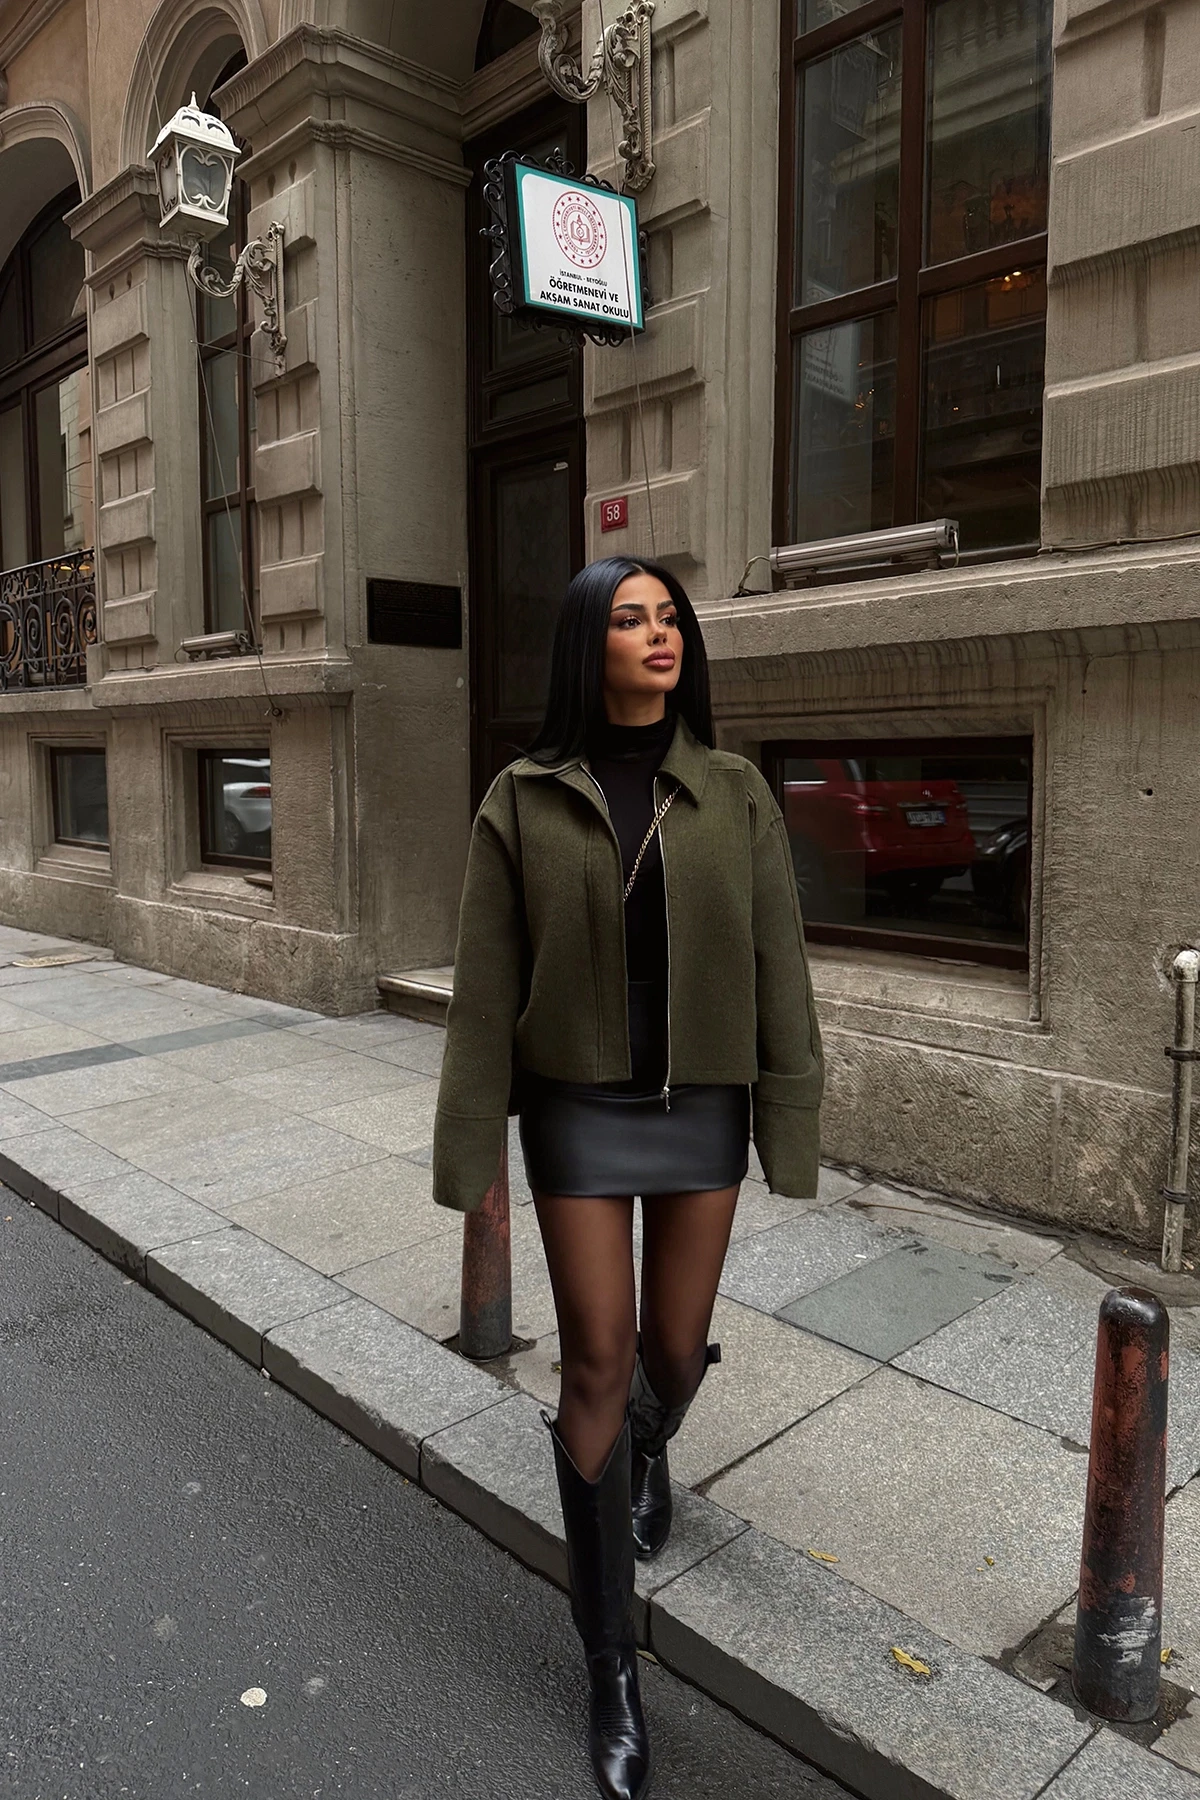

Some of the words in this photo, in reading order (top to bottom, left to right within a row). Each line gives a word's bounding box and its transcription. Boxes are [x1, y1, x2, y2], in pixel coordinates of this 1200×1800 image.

[560, 269, 582, 281] İSTANBUL
[586, 275, 608, 287] BEYOĞLU
[549, 276, 607, 300] ÖĞRETMENEVİ
[608, 292, 619, 303] VE
[540, 290, 571, 305] AKŞAM
[573, 298, 600, 312] SANAT
[602, 304, 629, 318] OKULU
[607, 504, 620, 522] 58
